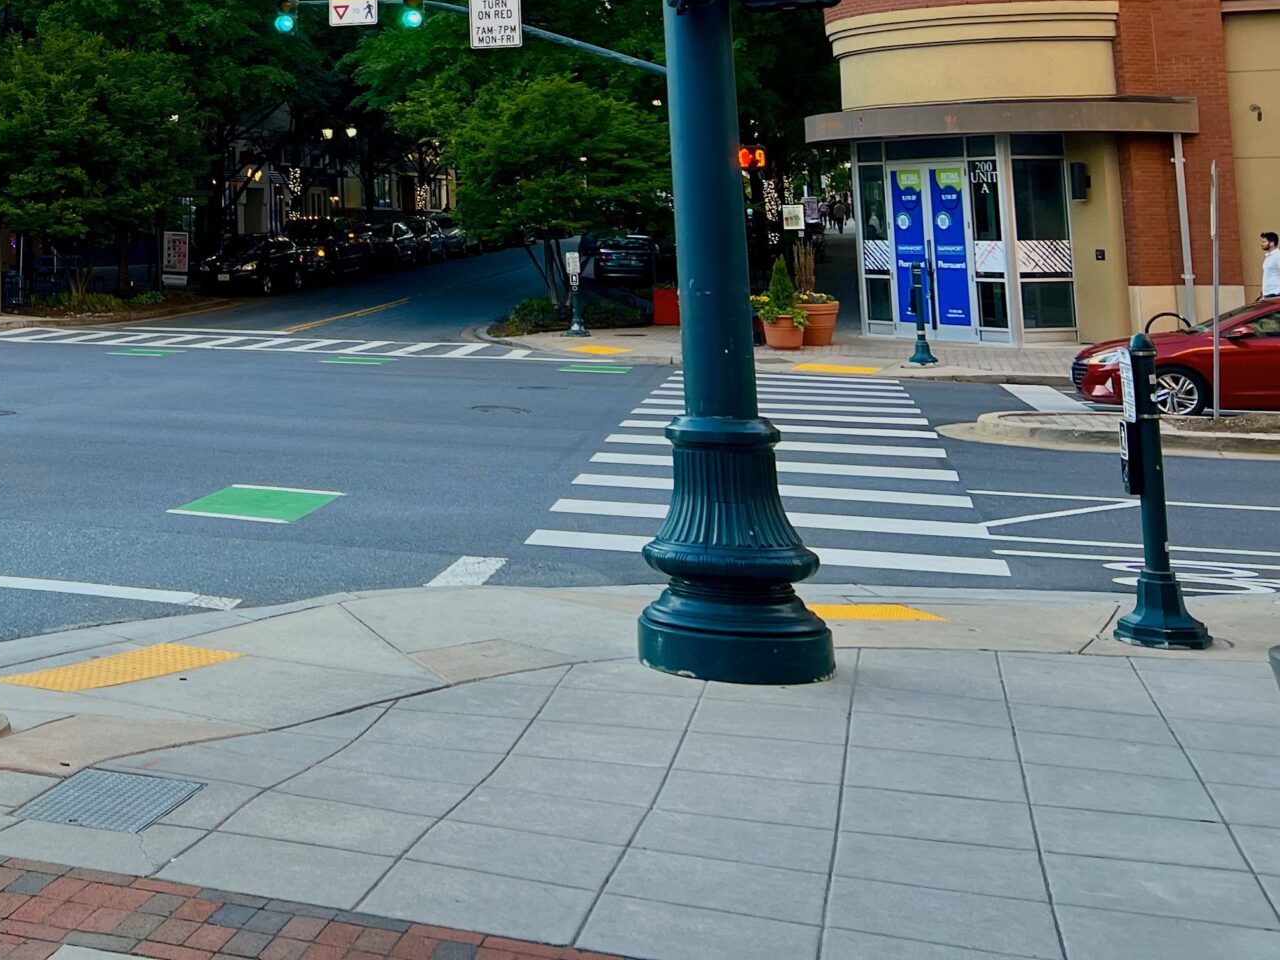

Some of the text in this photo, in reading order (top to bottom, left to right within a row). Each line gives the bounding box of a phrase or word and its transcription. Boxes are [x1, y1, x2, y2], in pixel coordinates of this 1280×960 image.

[482, 0, 508, 10] TURN
[477, 9, 513, 20] ON RED
[475, 25, 517, 35] 7AM-7PM
[477, 35, 515, 45] MON-FRI
[975, 161, 993, 172] 200
[970, 171, 998, 183] UNIT
[980, 183, 990, 194] A
